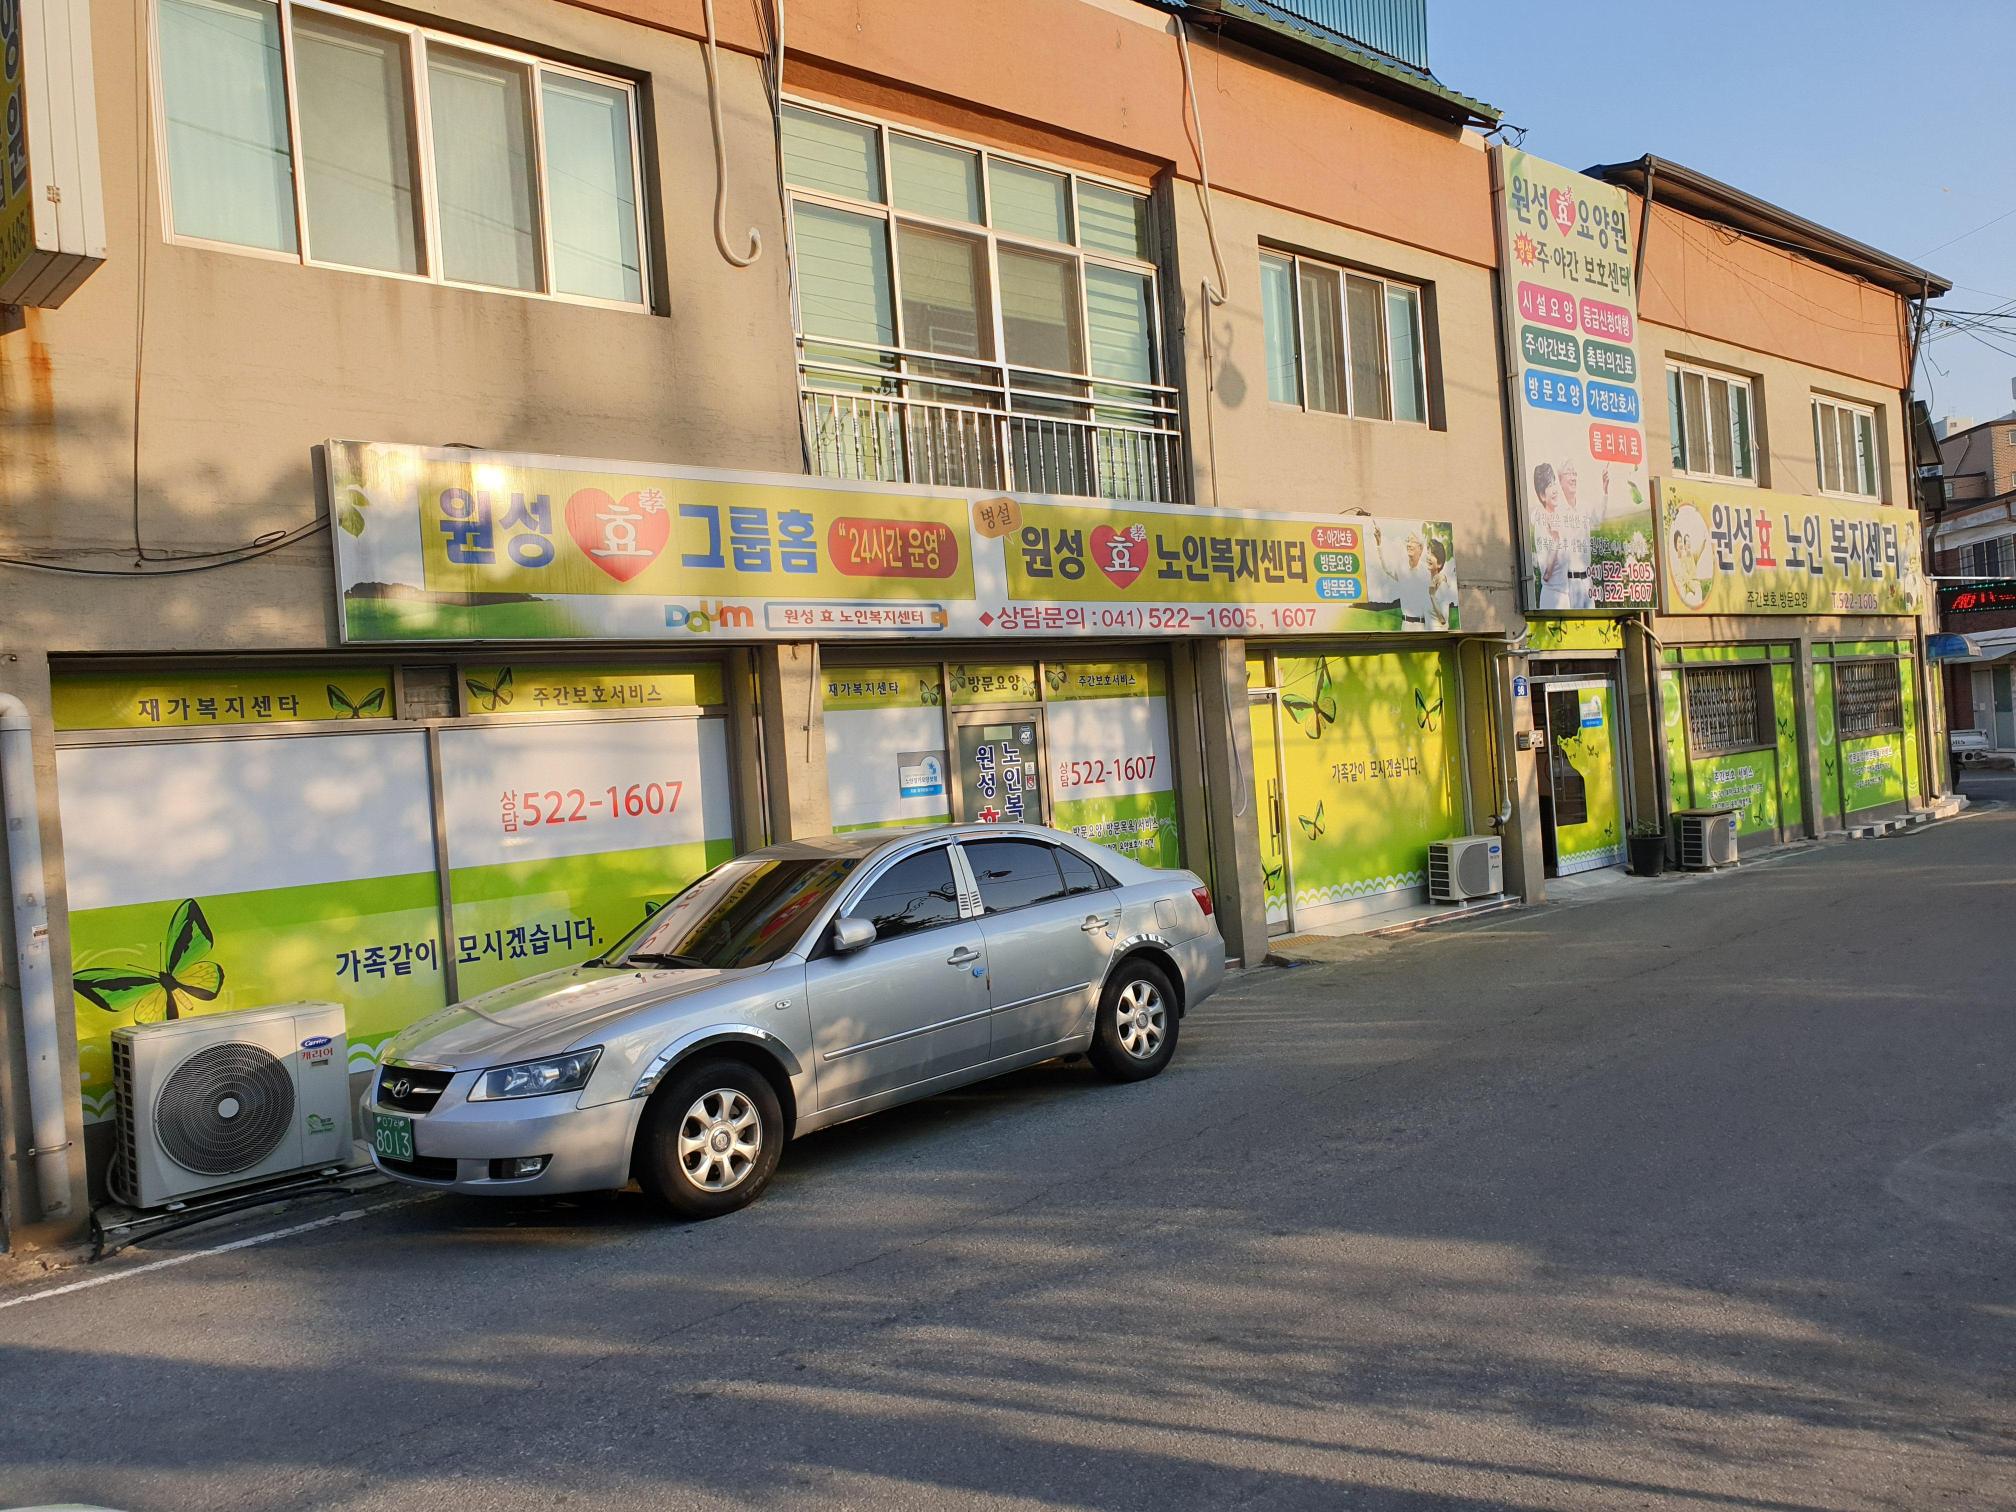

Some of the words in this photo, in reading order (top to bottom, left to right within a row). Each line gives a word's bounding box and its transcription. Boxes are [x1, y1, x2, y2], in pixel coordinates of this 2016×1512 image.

[1511, 175, 1549, 231] 원성
[1555, 195, 1572, 227] 효
[1577, 199, 1628, 255] 요양원
[1517, 236, 1534, 261] 병설
[1584, 255, 1631, 297] 보호센터
[1583, 305, 1631, 338] 등급신청대행
[1586, 347, 1634, 376] 촉탁의진료
[1590, 389, 1637, 417] 가정간호사
[438, 486, 557, 570] 원성
[590, 502, 654, 558] 효
[678, 502, 820, 574] 그룹홈
[980, 502, 1013, 530] 병설
[1021, 525, 1086, 581] 원성
[1103, 536, 1140, 574] 효
[1155, 533, 1308, 584] 노인복지센터
[1320, 554, 1353, 572] 방문요양
[1603, 562, 1651, 580] 522-1605
[1322, 579, 1355, 597] 방문목욕
[1605, 583, 1652, 601] 522-1607
[784, 609, 815, 626] 원성
[820, 609, 834, 623] 효
[840, 609, 925, 626] 노인복지센터
[828, 681, 899, 698] 재가복지센타
[967, 675, 1021, 693] 방문요양
[1078, 673, 1137, 688] 주간보호서비스
[138, 694, 299, 722] 재가복지센타
[533, 684, 663, 707] 주간보호서비스
[975, 745, 997, 798] 원성
[1001, 742, 1024, 823] 노인복
[1059, 761, 1069, 788] 상담
[1071, 755, 1157, 787] 522-1607
[1332, 761, 1366, 783] 가족같이
[1370, 756, 1421, 779] 모시겠습니다.
[500, 789, 518, 833] 상담
[522, 780, 683, 827] 522-1607
[336, 938, 438, 983] 가족같이
[458, 917, 604, 965] 모시겠습니다.
[304, 1037, 329, 1048] Carrier
[376, 1129, 411, 1157] 8013
